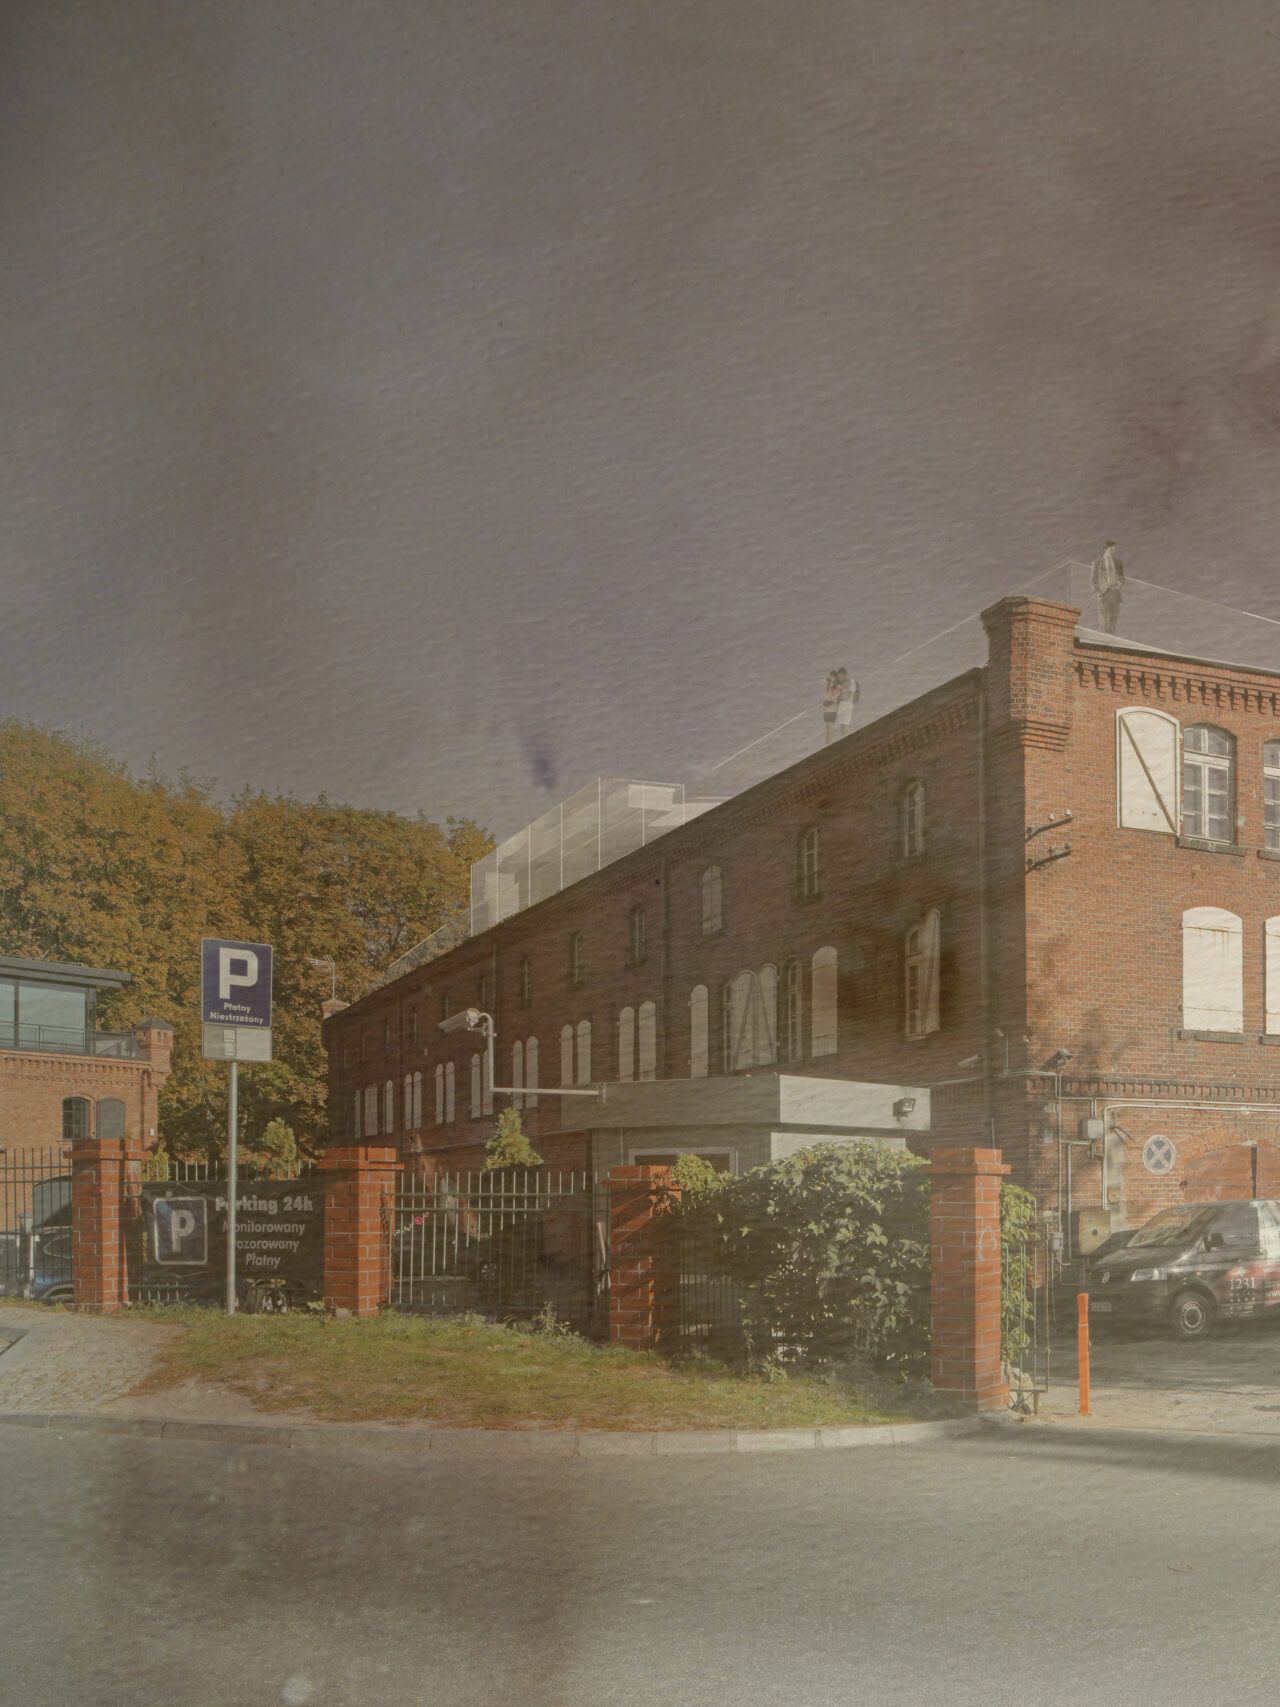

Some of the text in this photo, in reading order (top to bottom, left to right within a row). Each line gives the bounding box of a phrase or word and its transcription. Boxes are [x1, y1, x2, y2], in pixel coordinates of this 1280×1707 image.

[219, 947, 258, 1000] P
[223, 1002, 251, 1014] Płatny
[210, 1012, 264, 1025] Niestrzeżony
[283, 1196, 313, 1211] 24h
[171, 1209, 195, 1253] P
[236, 1239, 300, 1254] ozorowany
[246, 1253, 281, 1269] Płatny
[1230, 1277, 1256, 1290] 1231
